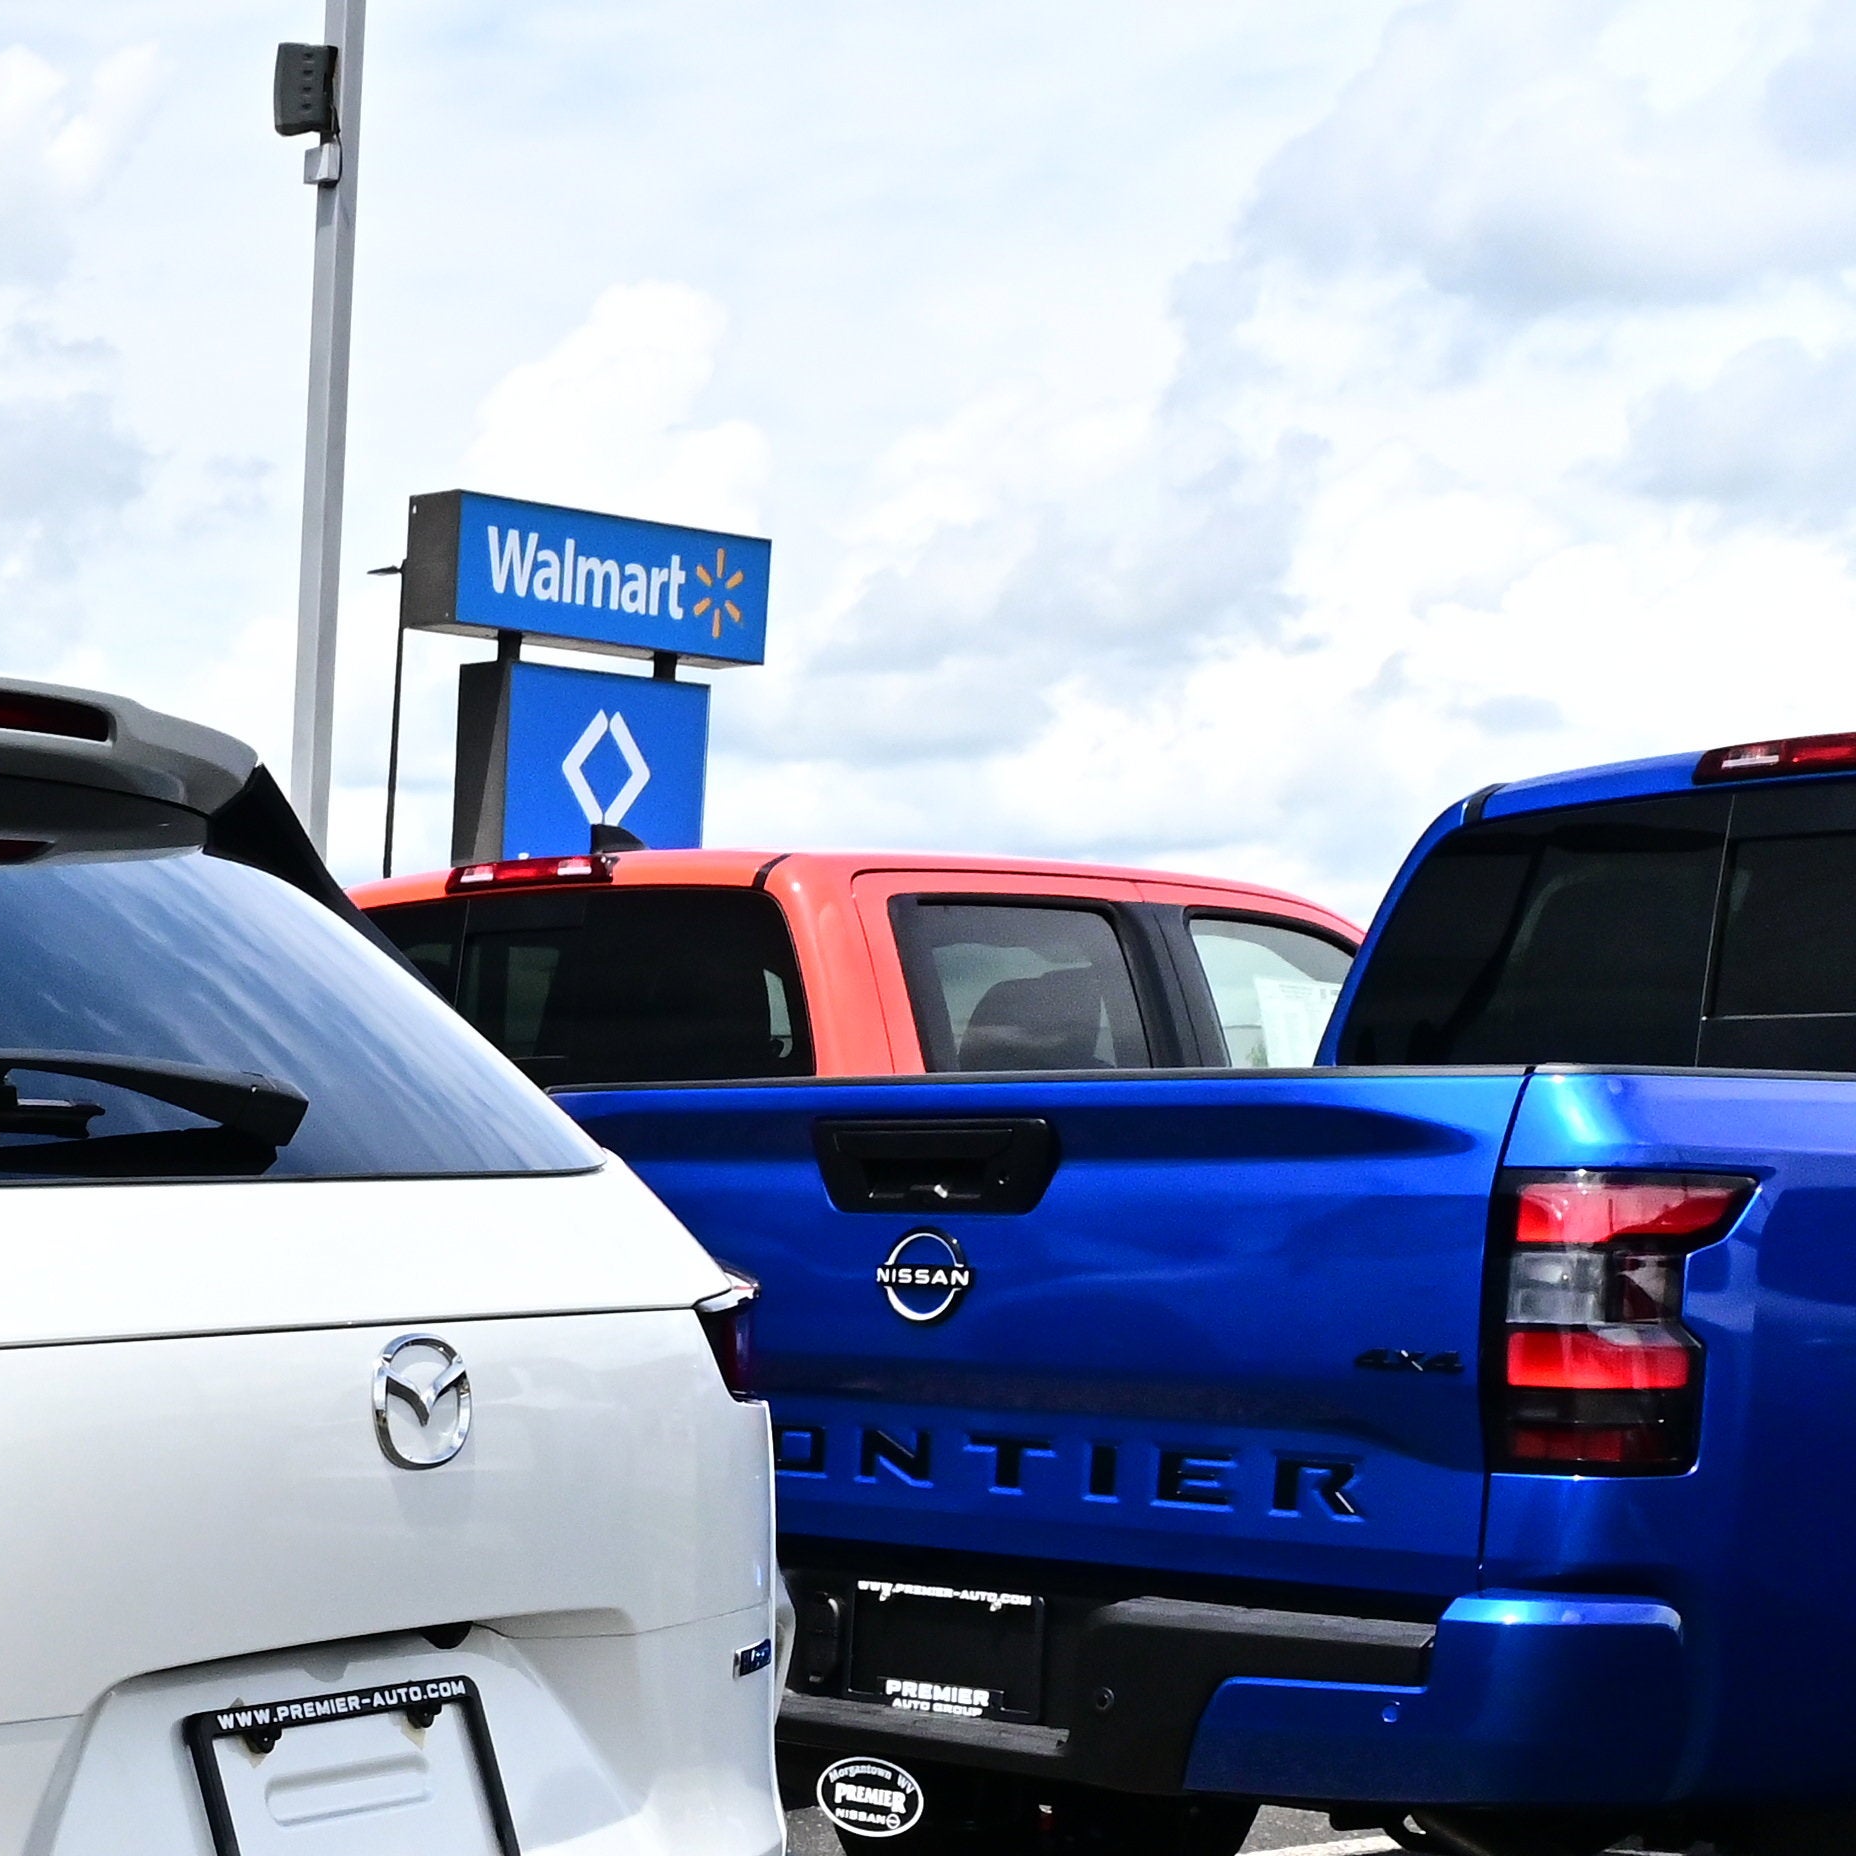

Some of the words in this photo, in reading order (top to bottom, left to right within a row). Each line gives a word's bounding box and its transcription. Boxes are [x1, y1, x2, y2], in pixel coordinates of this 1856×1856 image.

[486, 525, 686, 620] Walmart
[876, 1267, 969, 1286] NISSAN
[774, 1424, 1366, 1522] ONTIER
[217, 1679, 466, 1730] WWW.PREMIER-AUTO.COM
[886, 1679, 990, 1707] PREMIER
[892, 1697, 929, 1711] AUTO
[933, 1702, 982, 1717] GROUP
[829, 1764, 892, 1783] Morgantown
[897, 1773, 915, 1794] WV
[834, 1782, 906, 1814] PREMIER
[835, 1807, 886, 1825] NISSAN
